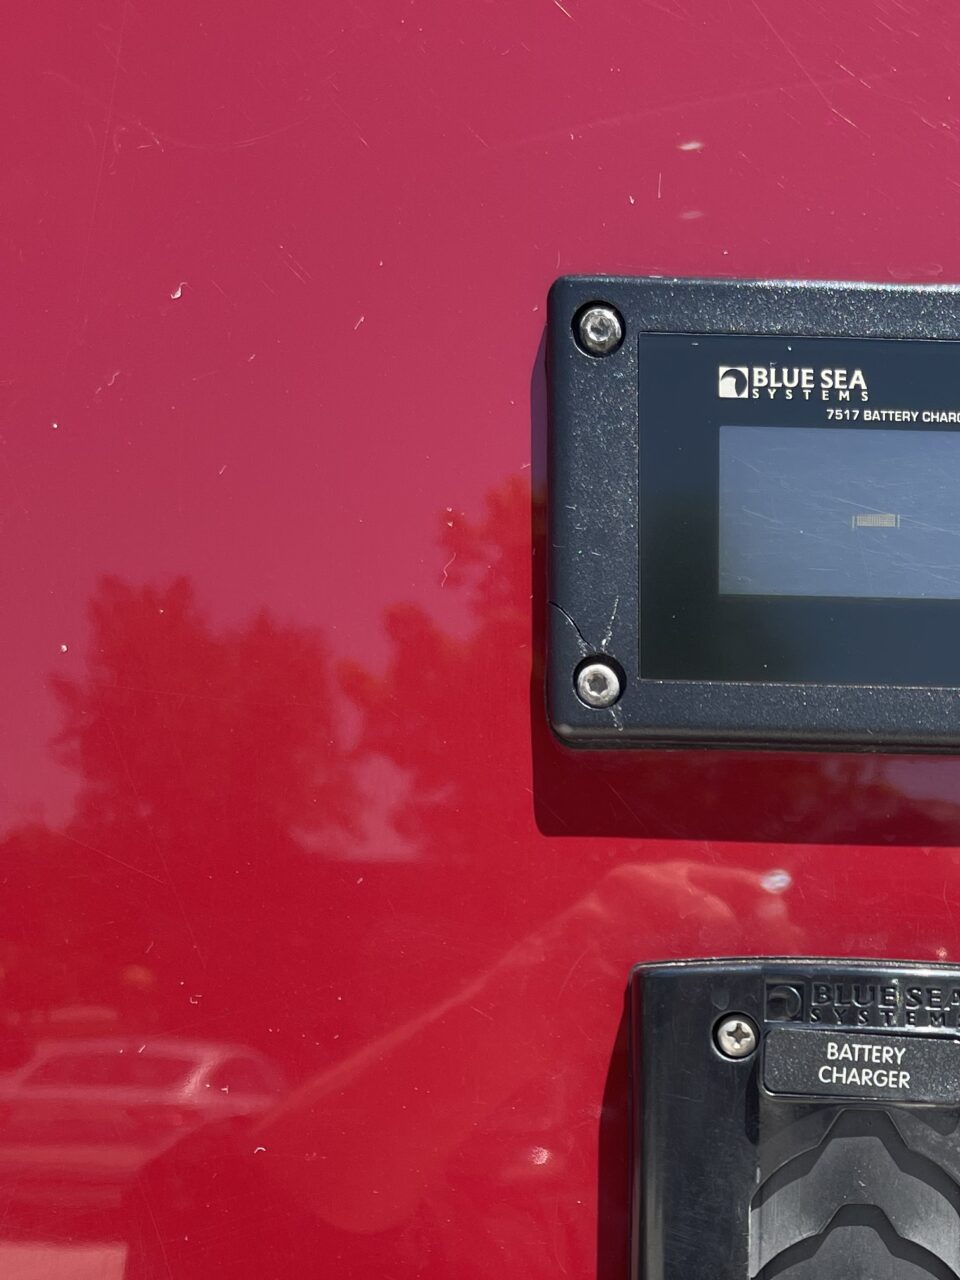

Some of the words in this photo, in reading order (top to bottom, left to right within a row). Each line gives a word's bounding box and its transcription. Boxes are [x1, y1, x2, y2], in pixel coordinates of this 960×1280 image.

[752, 367, 815, 389] BLUE
[820, 369, 868, 390] SEA
[752, 388, 869, 402] SYSTEMS
[825, 408, 860, 421] 7517
[863, 410, 919, 423] BATTERY
[811, 982, 896, 1009] BLUE
[826, 1041, 907, 1065] BATTERY
[818, 1065, 911, 1089] CHARGER
